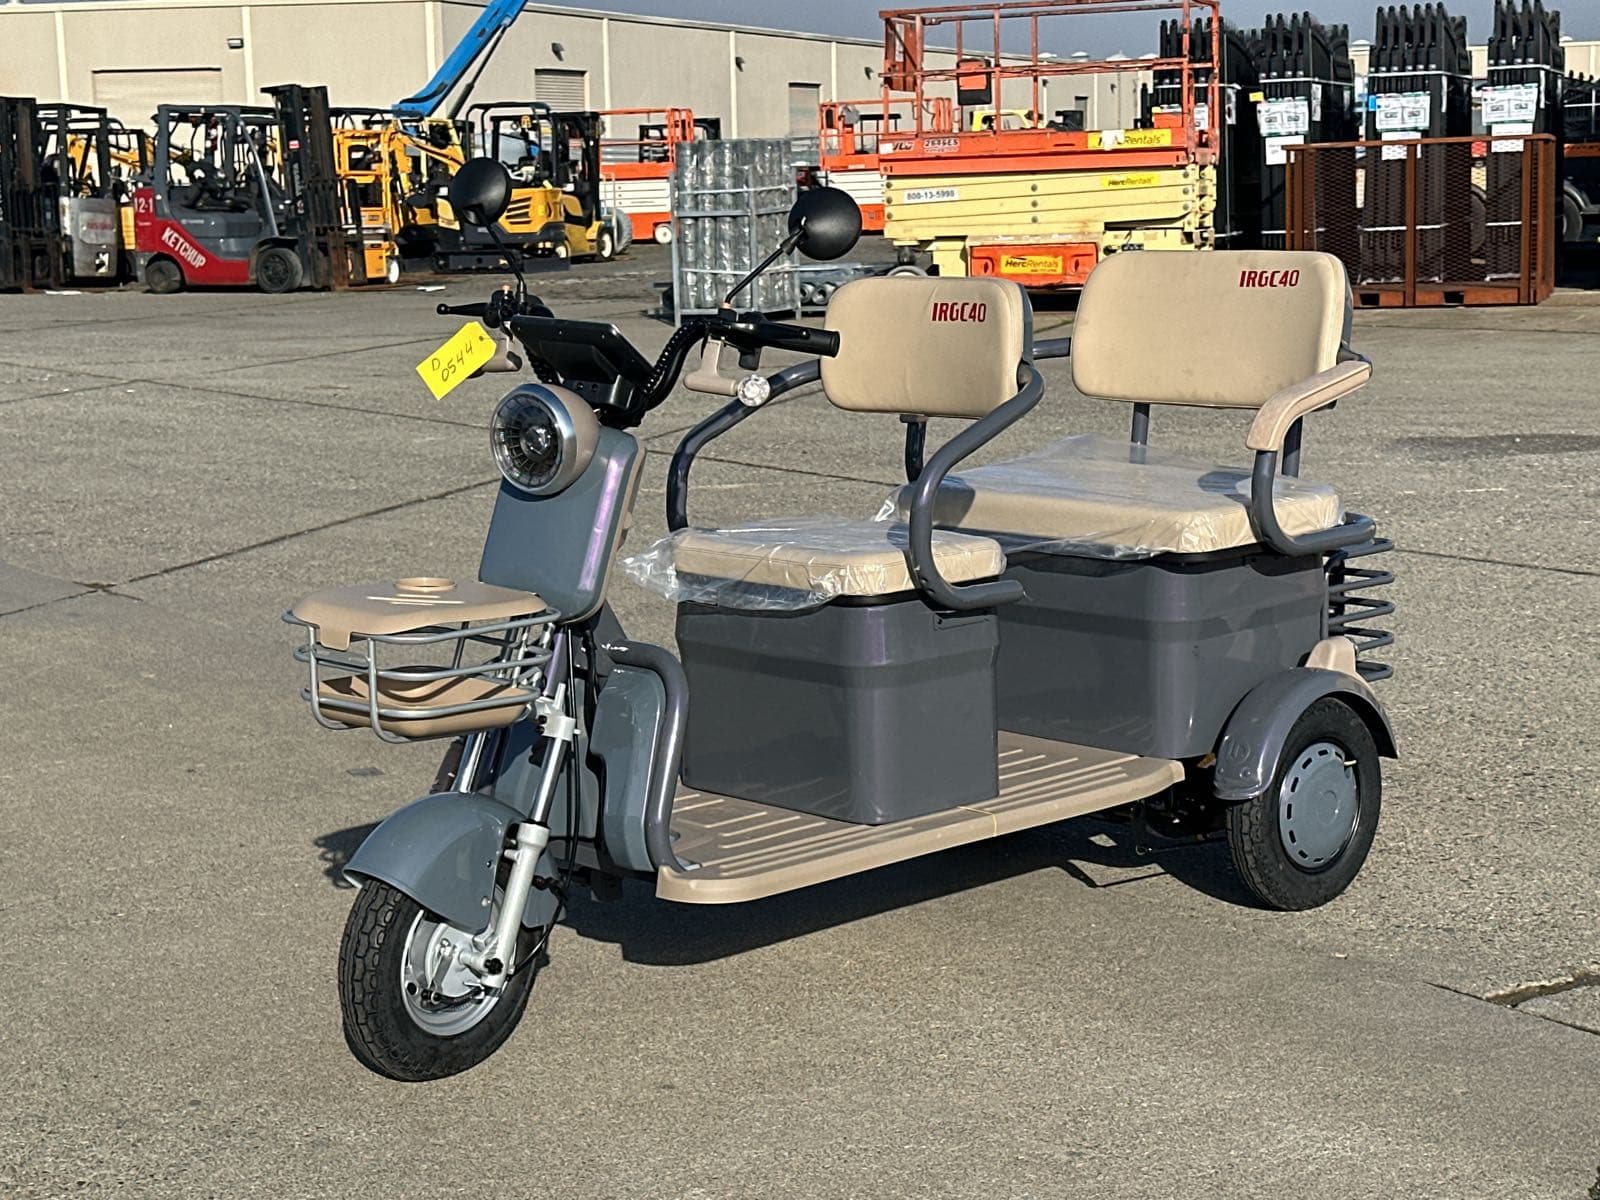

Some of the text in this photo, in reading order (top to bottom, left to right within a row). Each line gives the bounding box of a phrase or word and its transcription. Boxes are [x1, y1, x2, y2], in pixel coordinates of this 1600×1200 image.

[161, 227, 206, 268] KETCHUP
[1005, 259, 1058, 269] HercRentals
[1239, 269, 1300, 288] IRGC40
[932, 302, 987, 322] IRGC40
[431, 357, 441, 371] D
[441, 341, 474, 382] 0544
